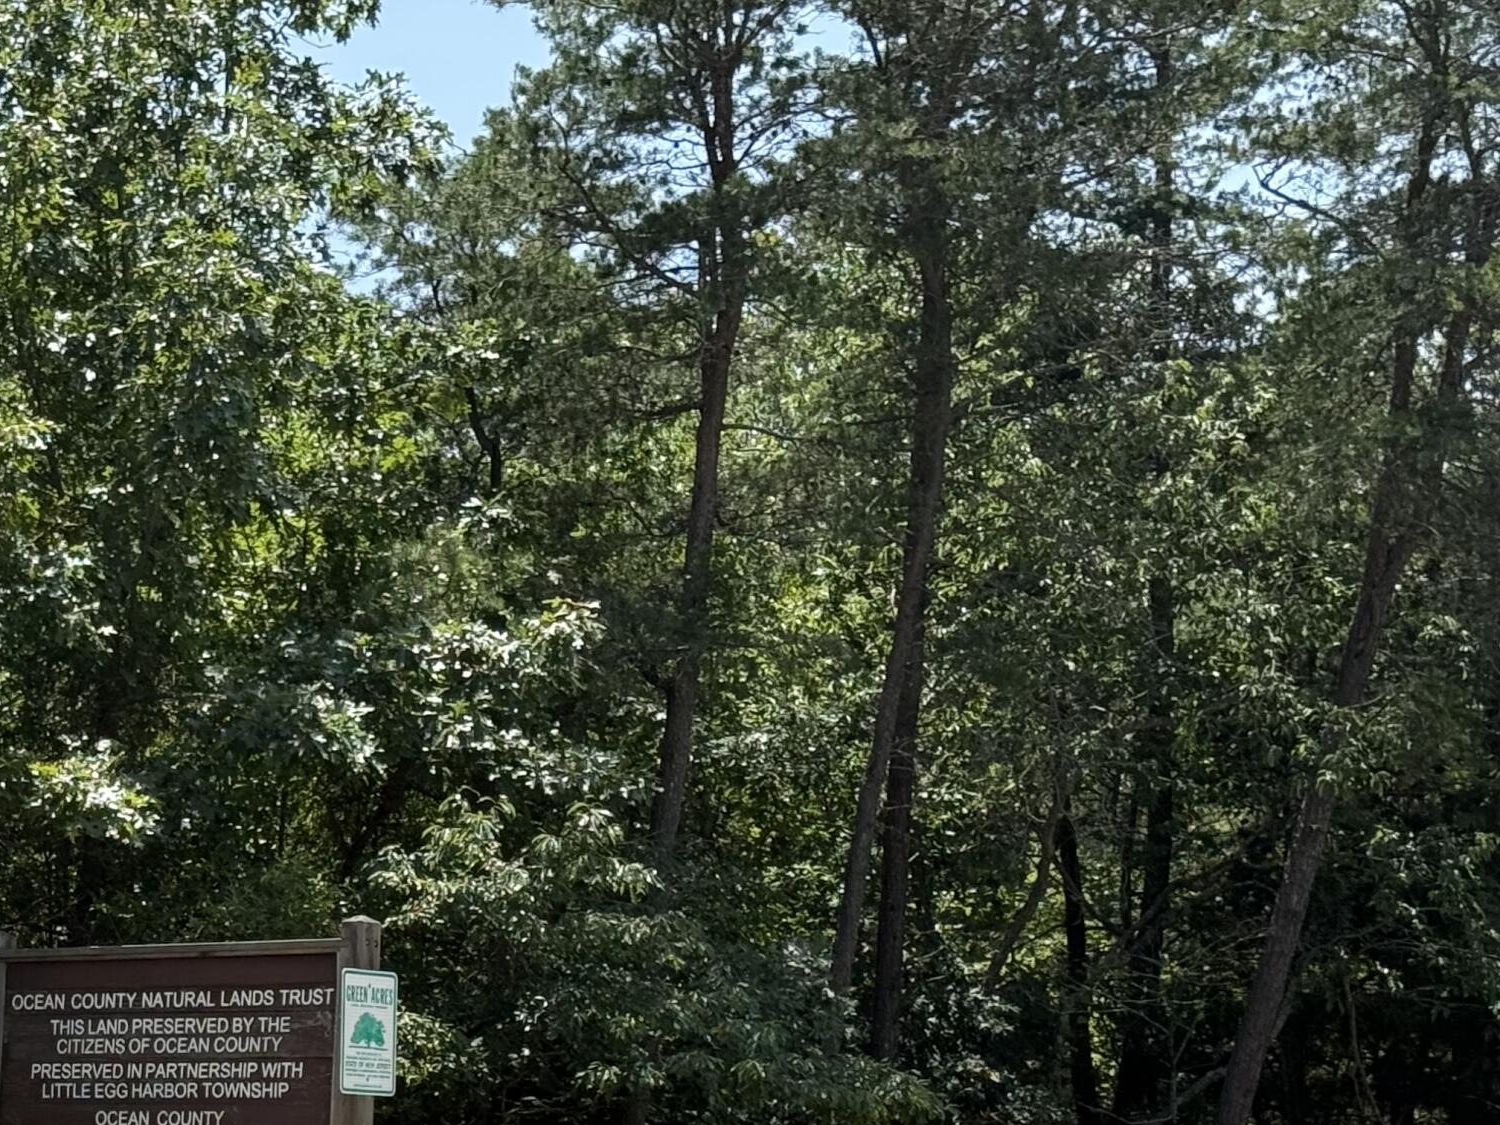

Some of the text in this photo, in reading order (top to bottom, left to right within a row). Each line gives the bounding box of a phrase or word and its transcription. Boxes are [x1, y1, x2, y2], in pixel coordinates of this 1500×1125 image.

[11, 987, 335, 1010] OCEAN COUNTY NATURAL LANDS TRUST
[347, 985, 393, 1005] GREEN ACRES
[50, 1016, 291, 1035] THIS LAND PRESERVED BY THE
[56, 1036, 283, 1055] CITIZENS OF OCEAN COUNTY
[31, 1061, 304, 1079] PRESERVED IN PARTNERSHIP WITH
[42, 1081, 290, 1099] LITTLE EGG HARBOR TOWNSHIP
